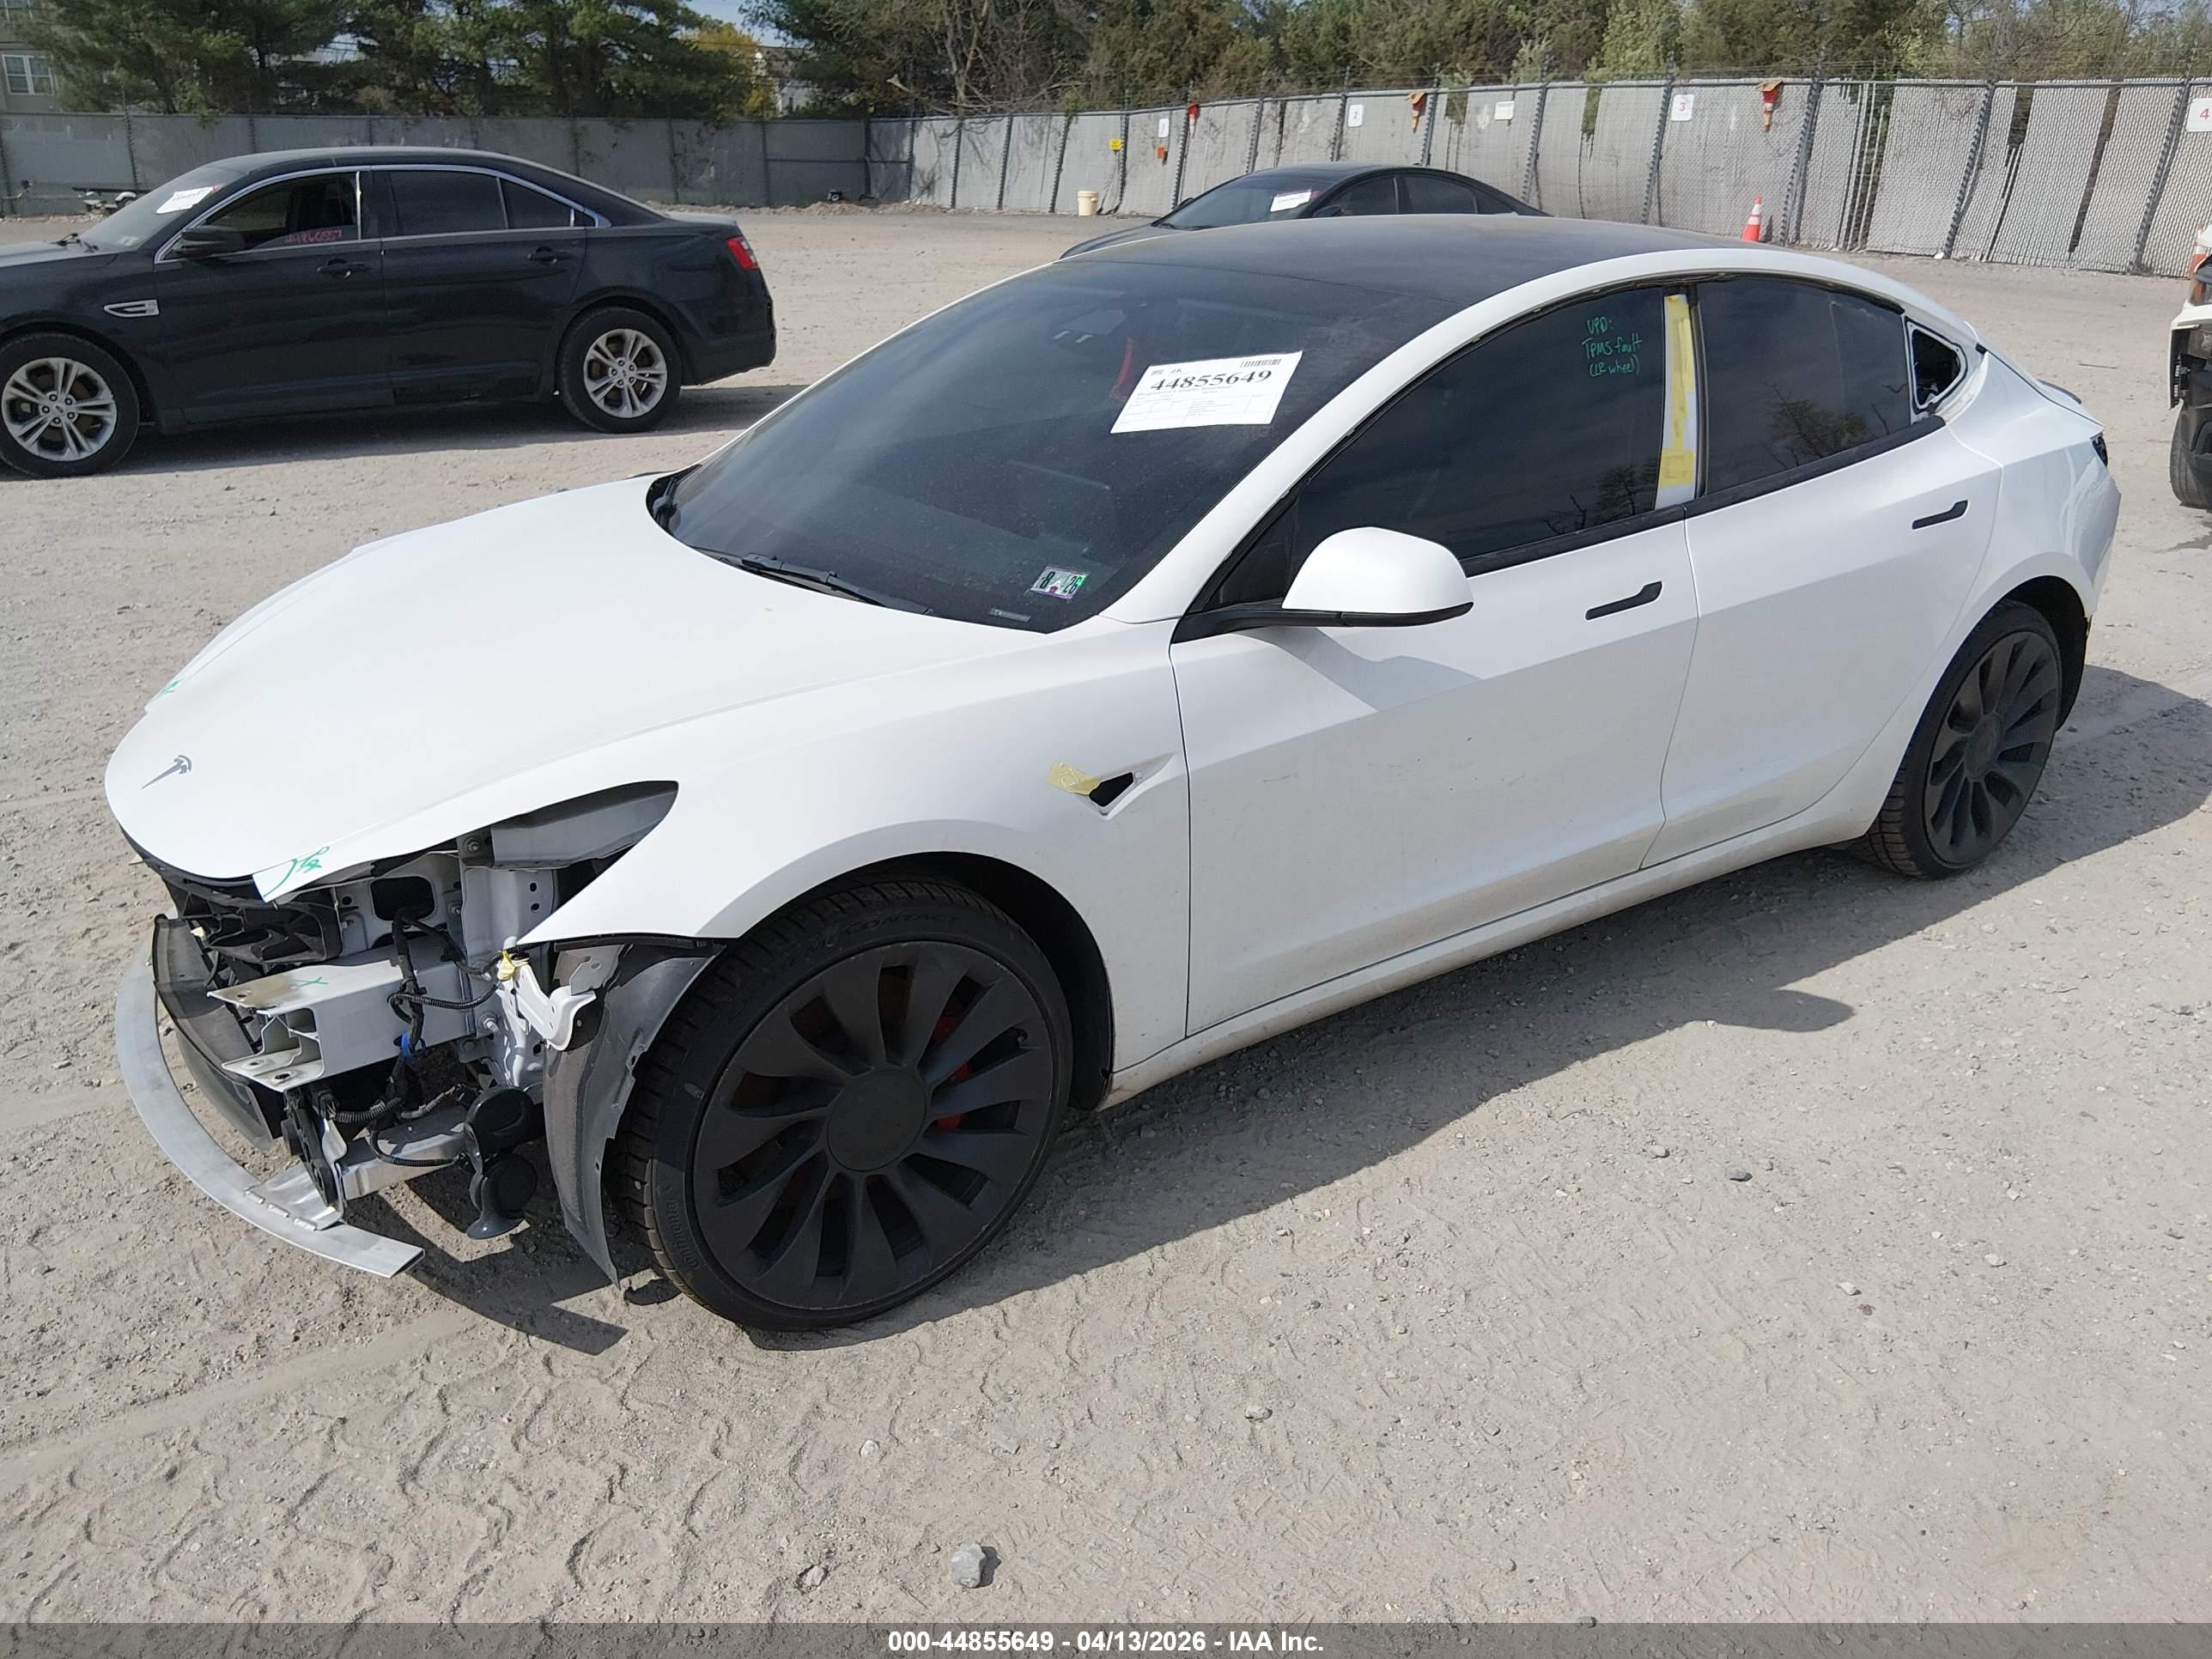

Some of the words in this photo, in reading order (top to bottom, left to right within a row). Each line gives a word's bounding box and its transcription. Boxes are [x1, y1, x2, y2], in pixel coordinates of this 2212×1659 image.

[1679, 102, 1686, 112] 3
[2199, 107, 2210, 120] 4
[1581, 337, 1613, 359] TPMS
[1614, 332, 1643, 353] fault
[1607, 354, 1640, 377] wheel)
[1150, 369, 1272, 391] 44855649
